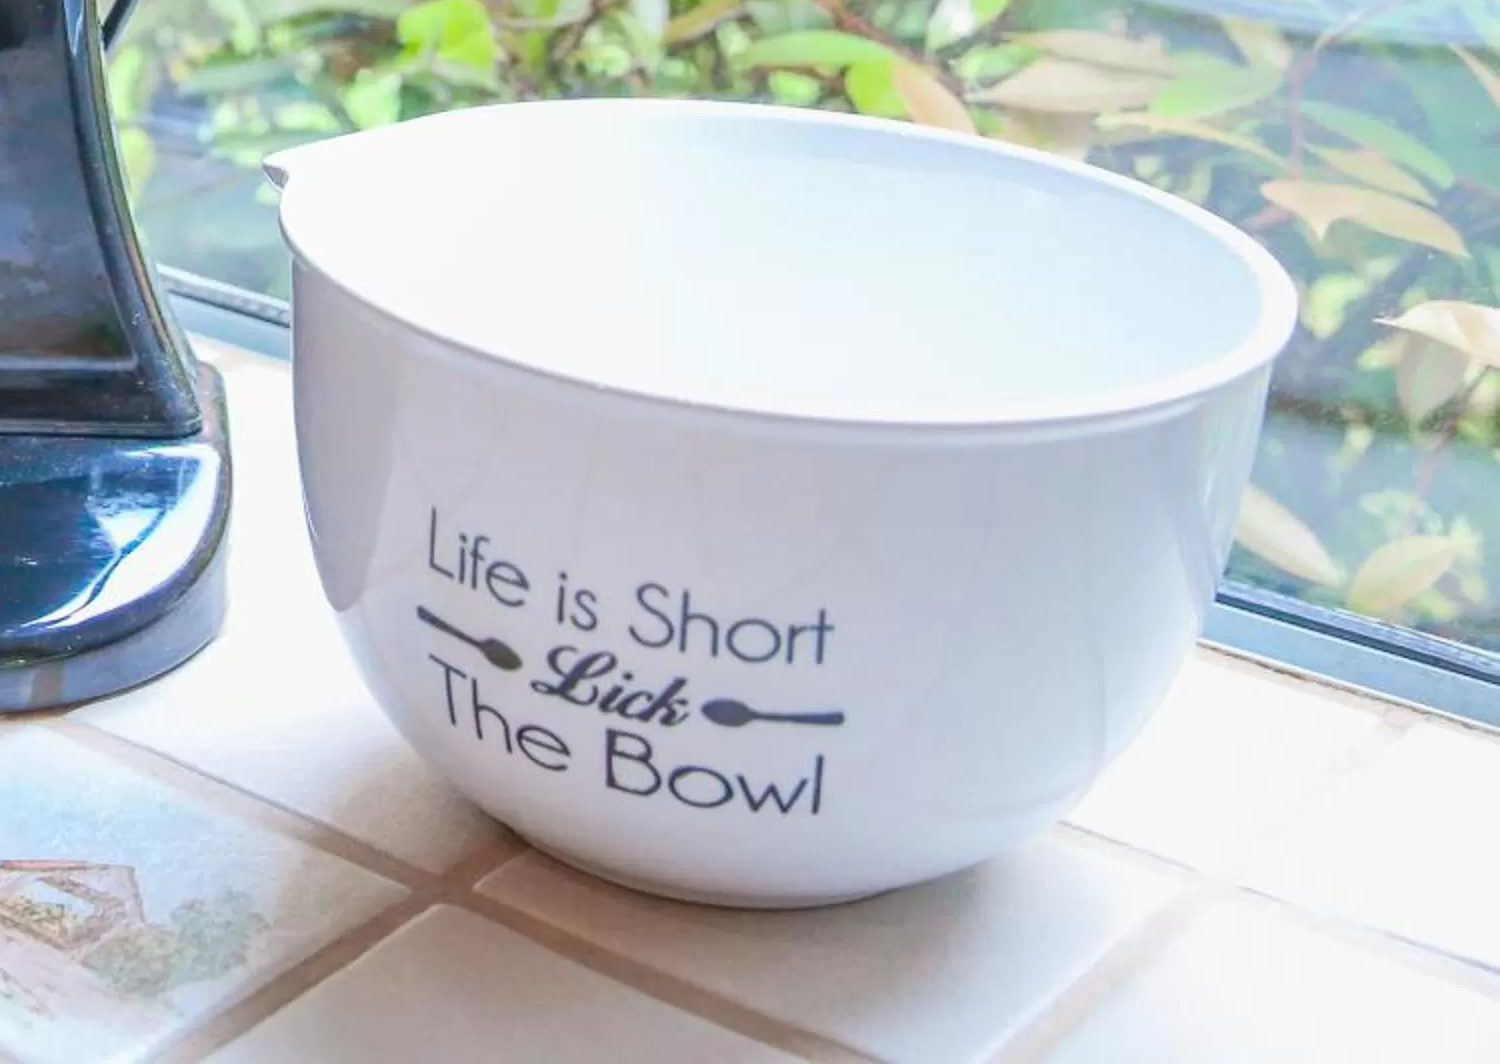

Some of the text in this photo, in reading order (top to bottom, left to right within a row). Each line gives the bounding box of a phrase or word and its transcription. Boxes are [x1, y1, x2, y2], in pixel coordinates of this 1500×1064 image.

[427, 505, 835, 665] Life is Short
[427, 652, 825, 816] The Bowl
[529, 644, 691, 728] Lick
